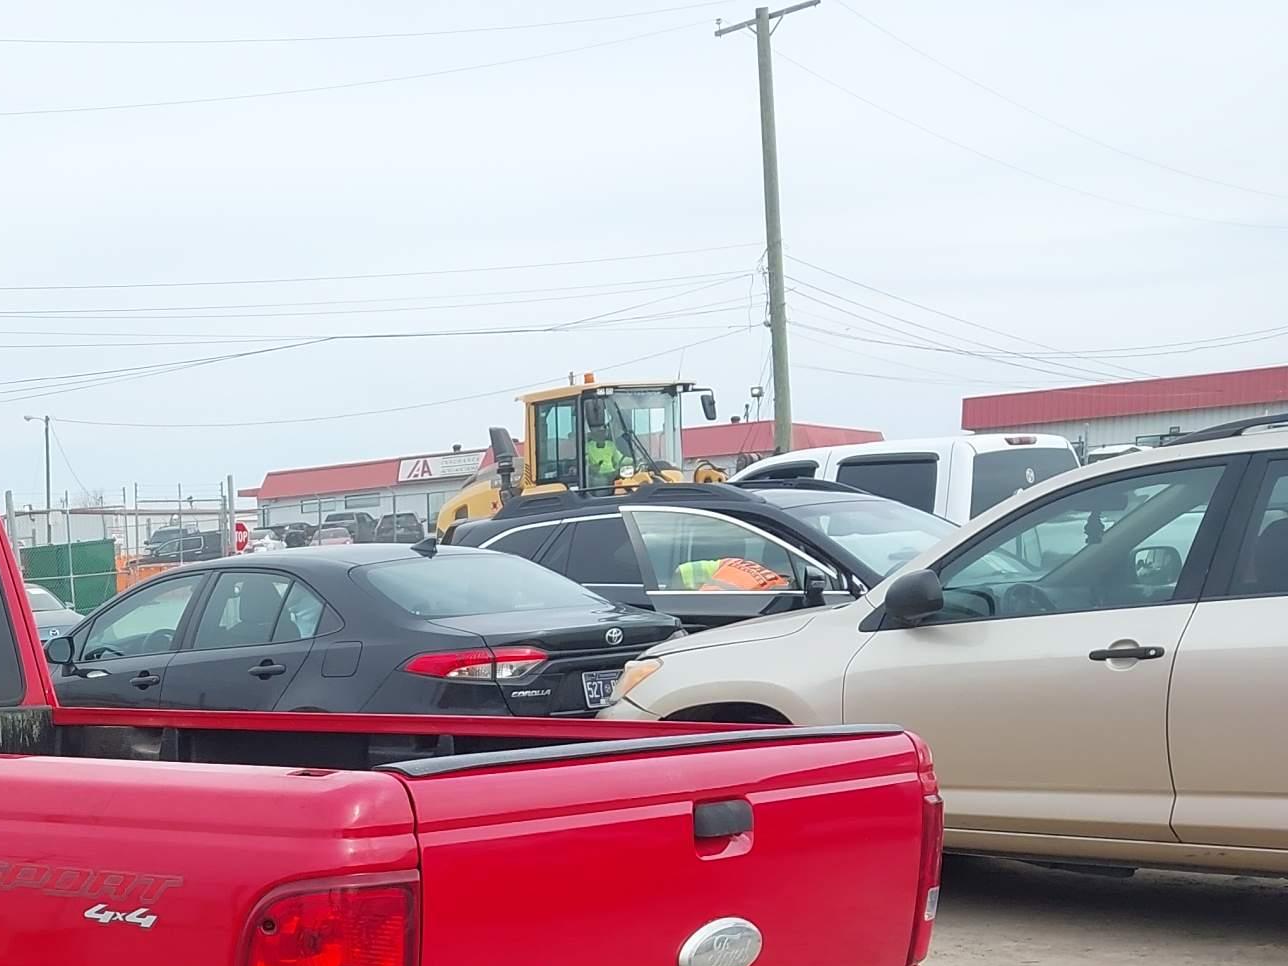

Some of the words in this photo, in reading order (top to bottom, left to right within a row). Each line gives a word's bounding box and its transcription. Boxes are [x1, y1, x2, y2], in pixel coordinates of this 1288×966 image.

[235, 531, 248, 543] TOP
[511, 688, 552, 698] COROLLA
[586, 681, 605, 698] 527
